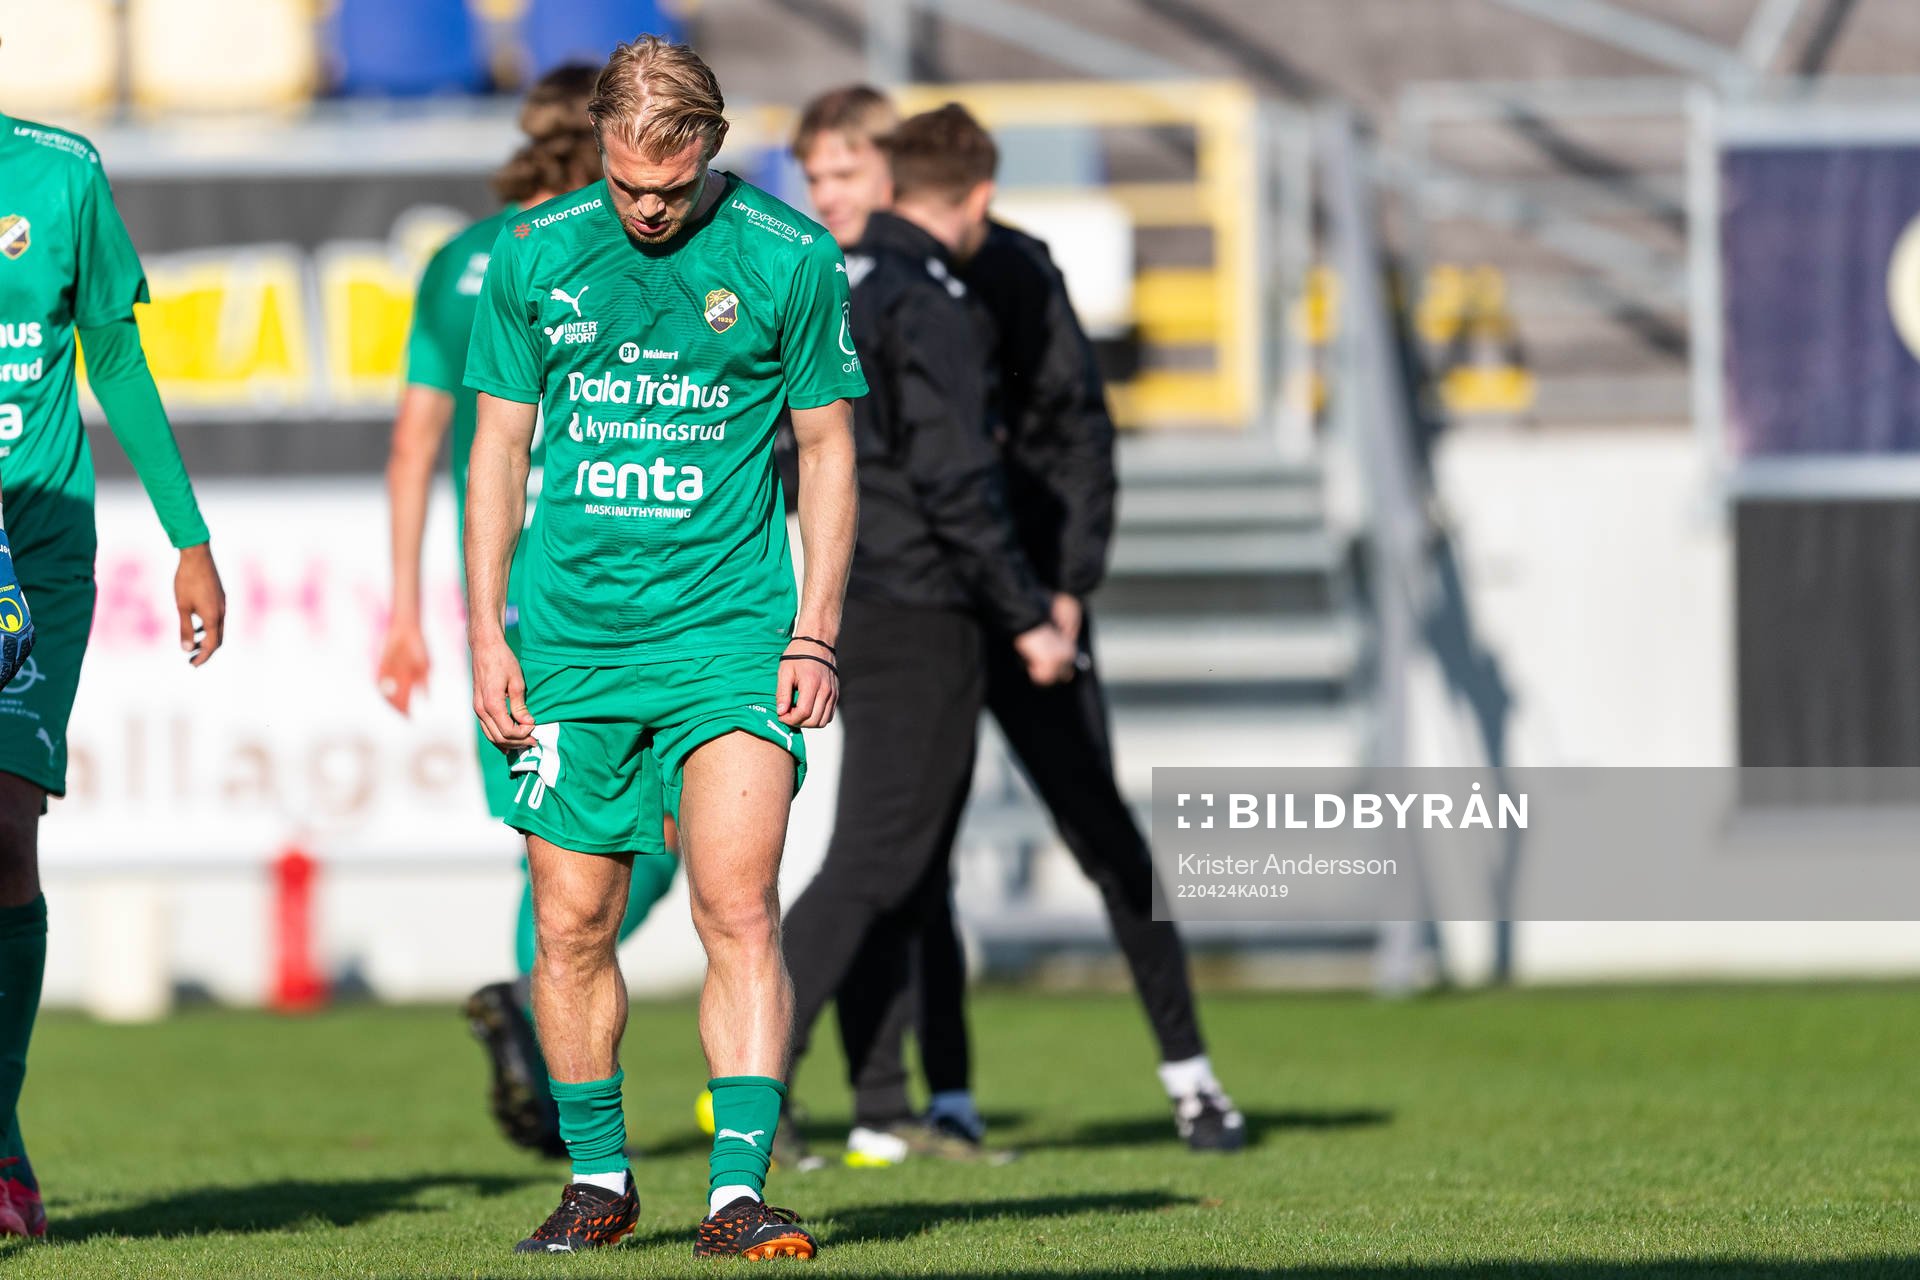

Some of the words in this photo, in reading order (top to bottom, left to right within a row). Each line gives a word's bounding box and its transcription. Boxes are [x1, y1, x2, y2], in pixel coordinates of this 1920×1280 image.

[531, 198, 603, 229] Takorama
[731, 199, 801, 238] LIFTEXPERTEN
[564, 321, 598, 334] INTER
[564, 331, 598, 345] SPORT
[623, 346, 636, 358] BT
[567, 371, 632, 404] Dala
[636, 373, 731, 408] Trähus
[586, 415, 727, 444] kynningsrud
[574, 457, 704, 502] renta
[585, 503, 692, 519] MASKINUTHYRNING
